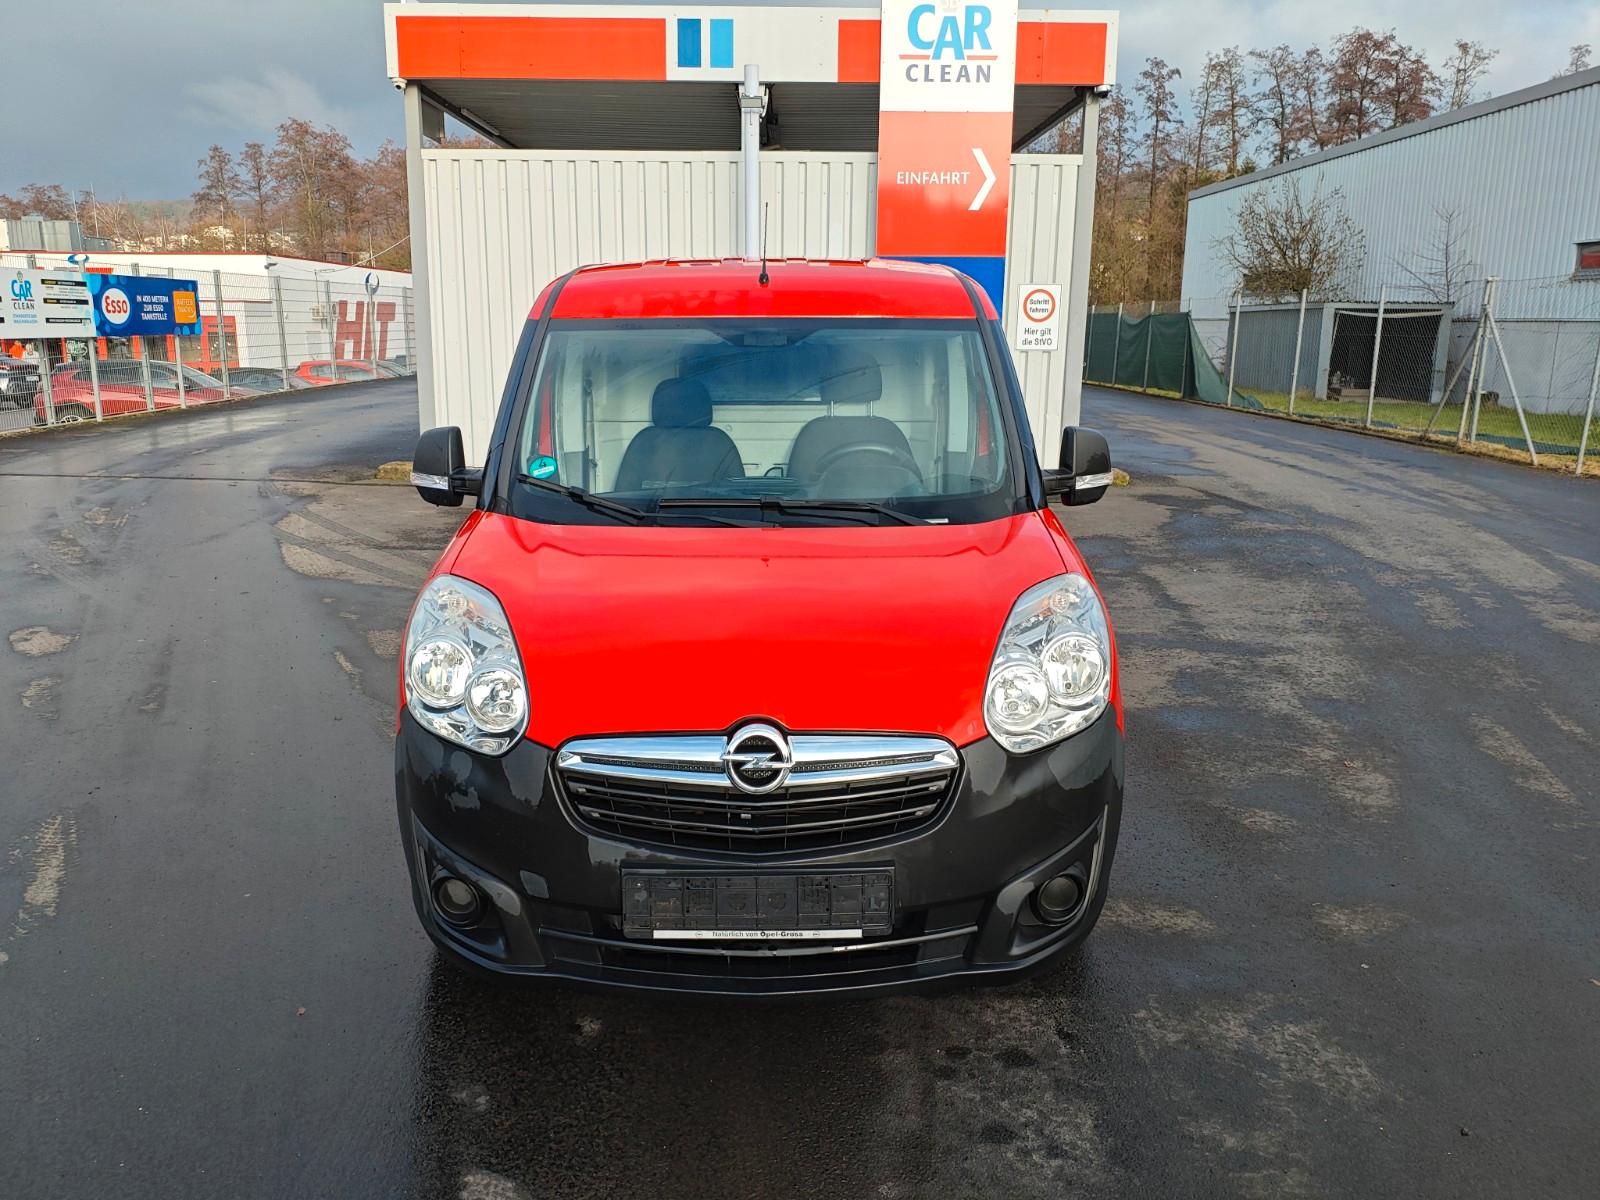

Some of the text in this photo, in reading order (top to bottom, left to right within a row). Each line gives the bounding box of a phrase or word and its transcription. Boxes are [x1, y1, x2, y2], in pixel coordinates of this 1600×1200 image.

[907, 4, 992, 60] CAR
[905, 64, 991, 83] CLEAN
[896, 171, 970, 185] EINFAHRT
[11, 279, 33, 301] CAR
[13, 302, 35, 310] CLEAN
[335, 300, 396, 360] HIT
[1024, 327, 1052, 337] Hier gilt
[1022, 337, 1053, 346] die StVO
